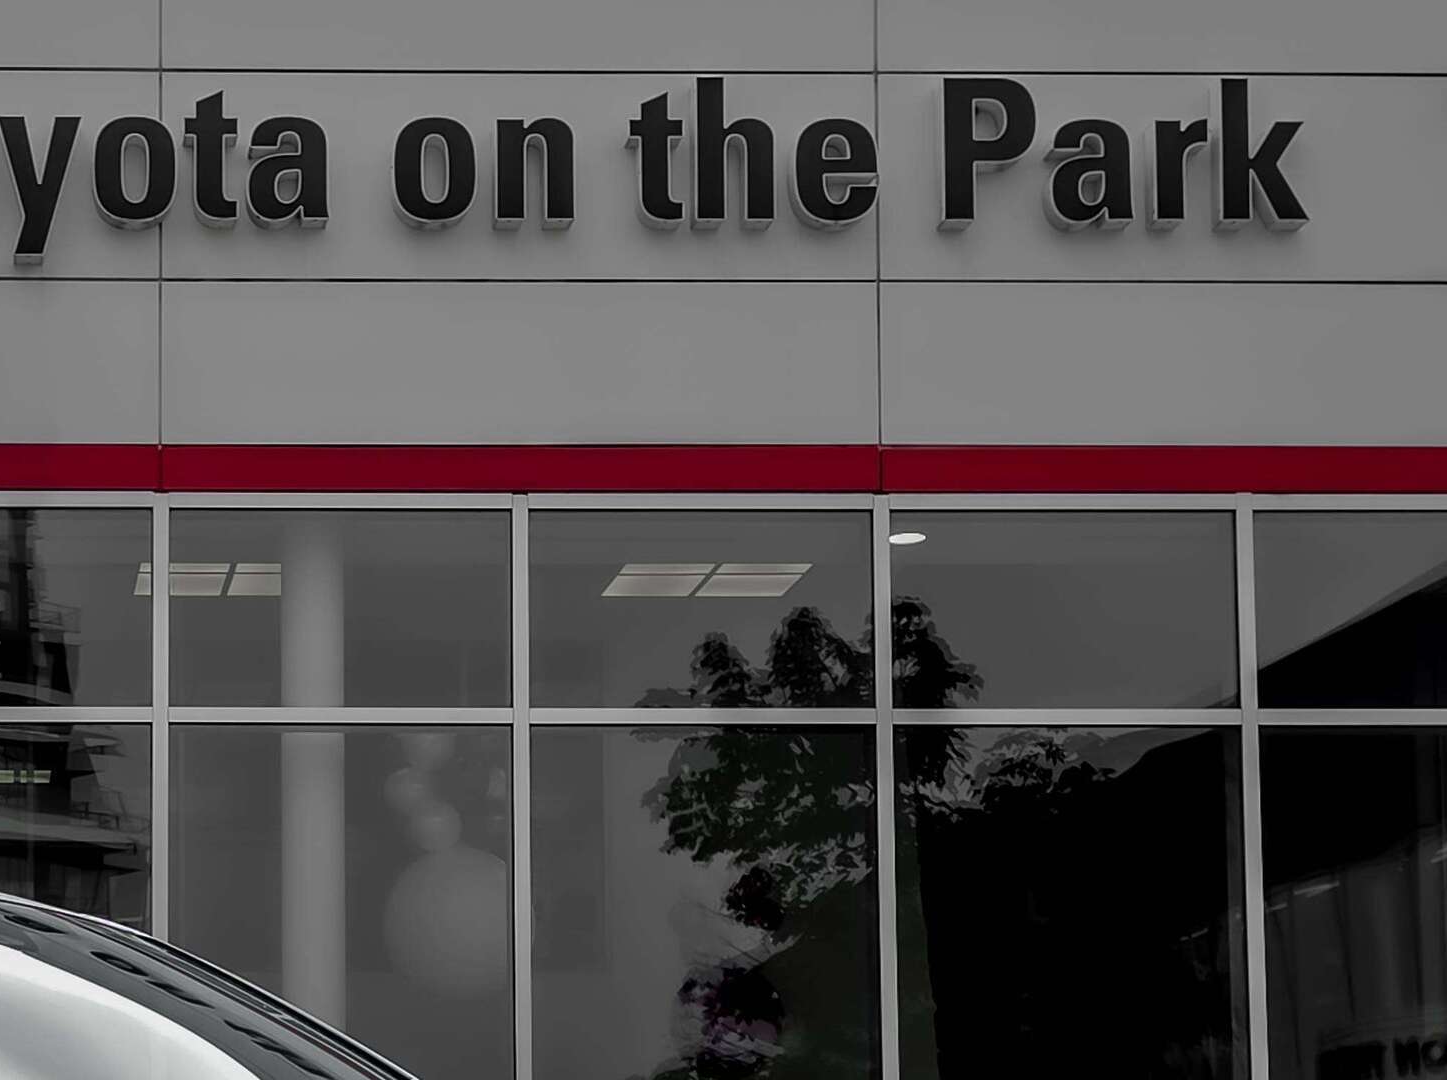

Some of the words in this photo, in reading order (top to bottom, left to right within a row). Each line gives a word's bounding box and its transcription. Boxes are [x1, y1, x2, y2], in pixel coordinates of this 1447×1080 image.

[393, 115, 575, 229] on
[627, 77, 879, 230] the
[939, 76, 1310, 230] Park
